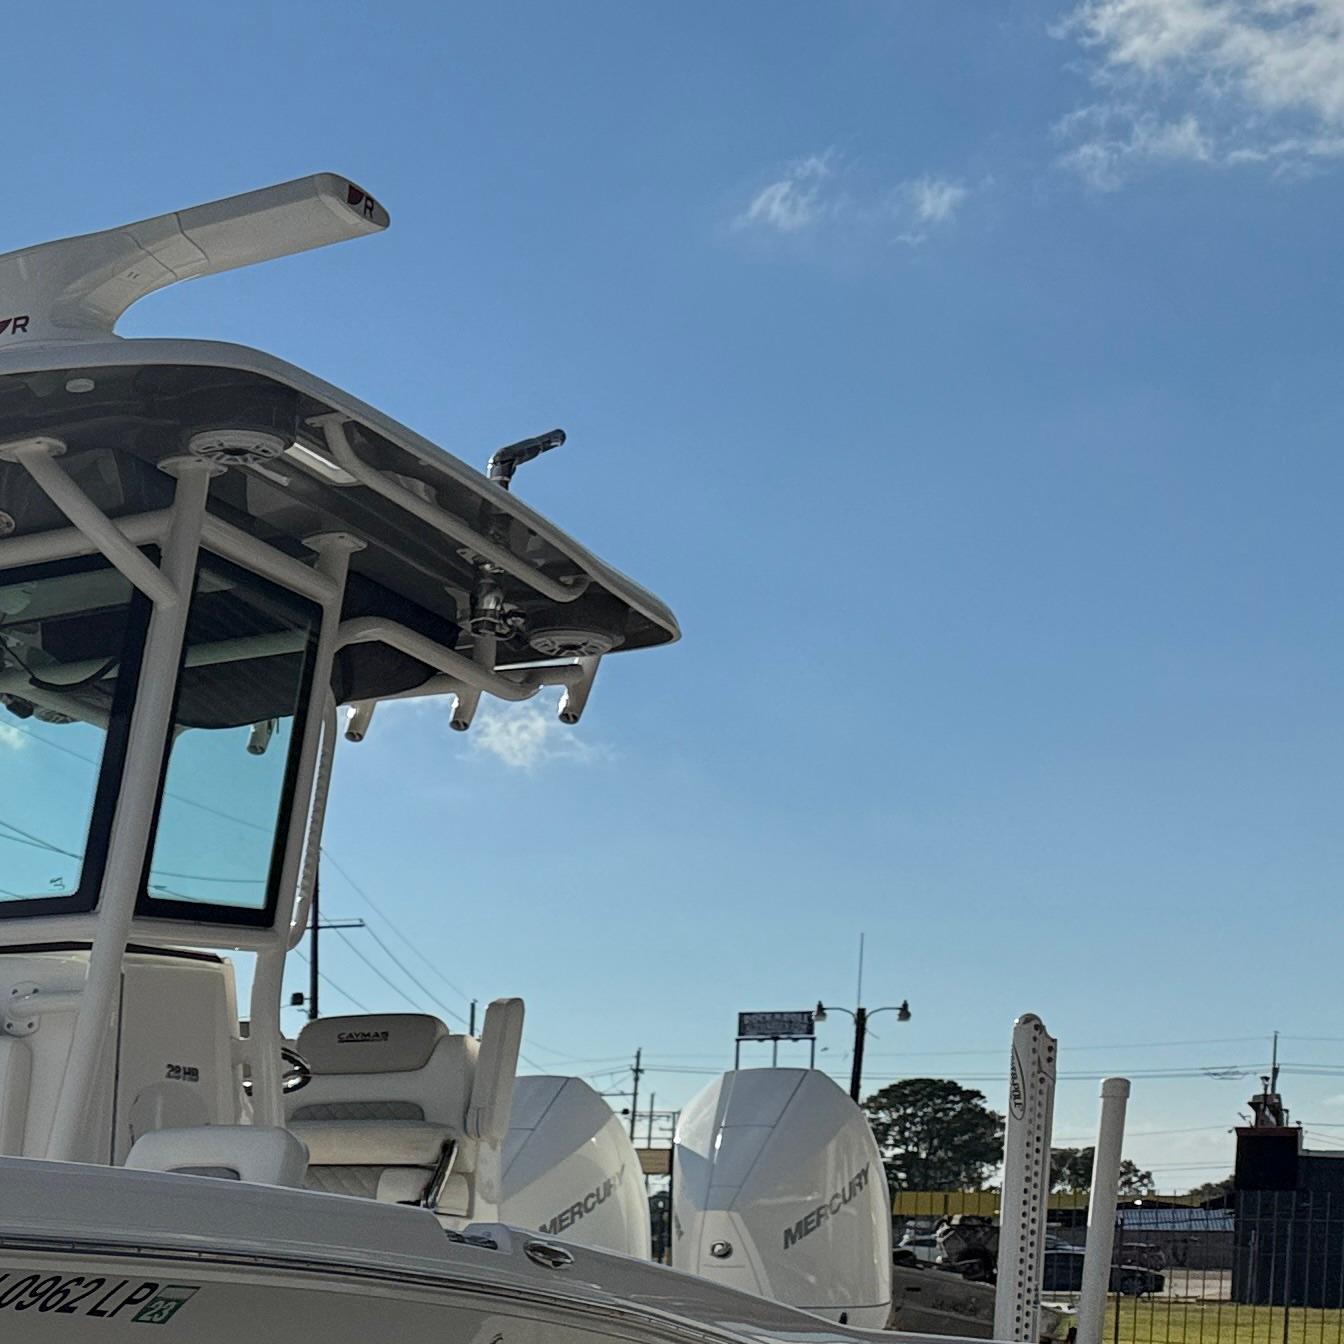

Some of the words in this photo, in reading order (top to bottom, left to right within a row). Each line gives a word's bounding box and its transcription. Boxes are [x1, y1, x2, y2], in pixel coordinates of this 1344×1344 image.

[364, 196, 374, 220] R
[11, 315, 30, 335] R
[337, 1031, 390, 1044] CAYMAS
[538, 1163, 627, 1236] MERCURY
[783, 1161, 870, 1250] MERCURY
